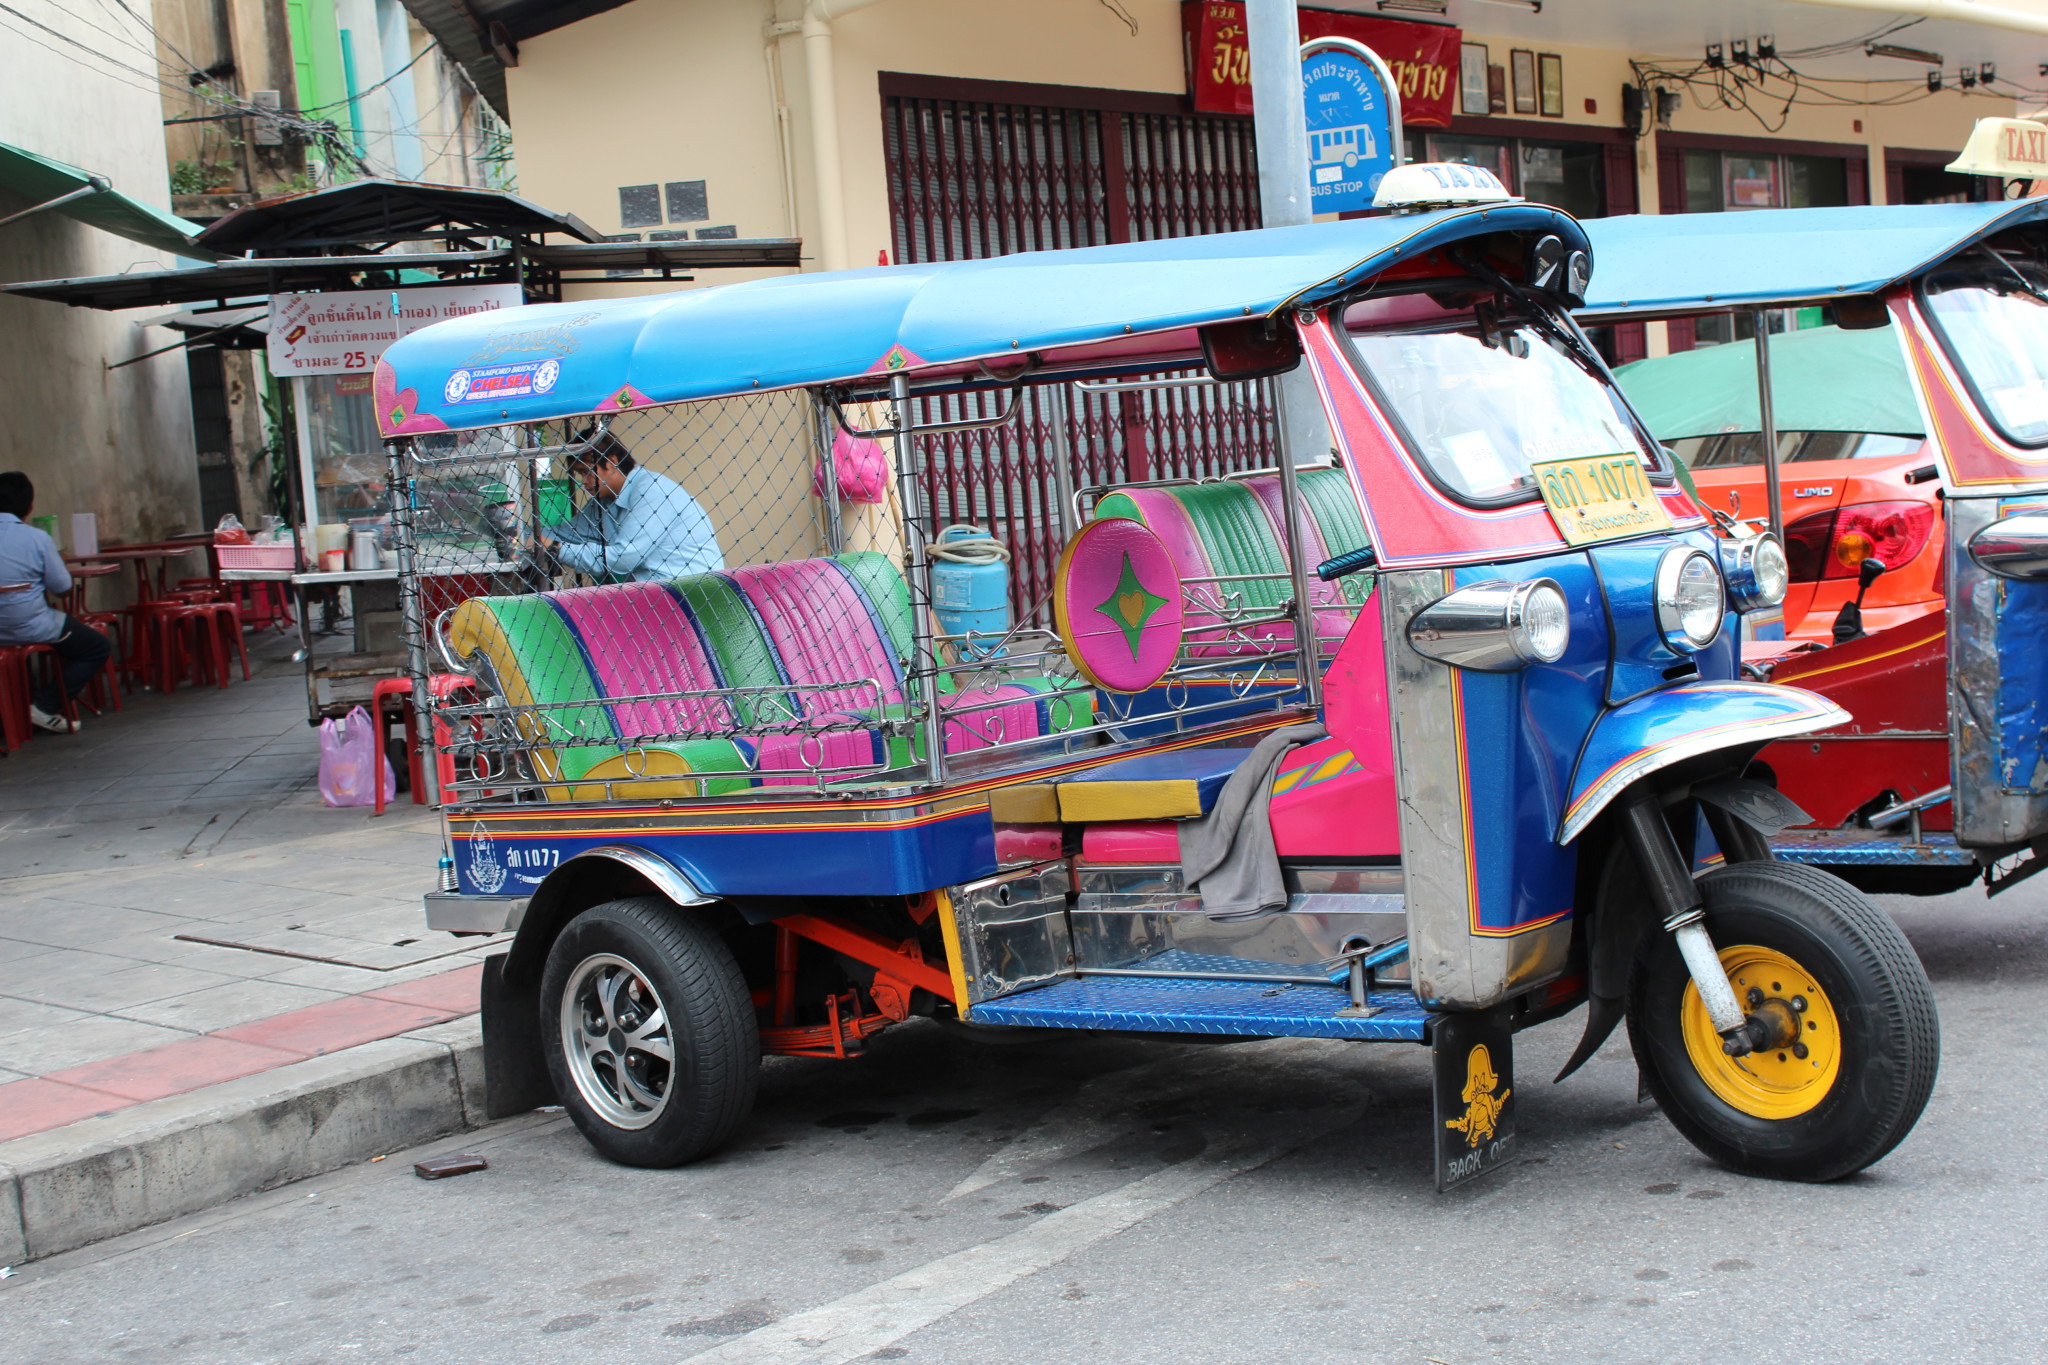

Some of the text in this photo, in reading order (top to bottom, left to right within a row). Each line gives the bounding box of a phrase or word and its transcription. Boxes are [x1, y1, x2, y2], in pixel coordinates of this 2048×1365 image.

[2004, 127, 2047, 164] TAXI
[1422, 165, 1501, 189] TAXI
[1310, 181, 1364, 197] BUS STOP
[307, 301, 383, 326] ลูกชิ้นดิ้นได้
[343, 351, 367, 369] 25
[471, 363, 540, 378] STAMFORD BRIDGE
[470, 373, 531, 392] CHELSEA
[1543, 459, 1645, 508] สก 1077
[1794, 486, 1833, 498] LIMO
[506, 846, 560, 868] สก 1077
[1446, 1148, 1483, 1183] BACK
